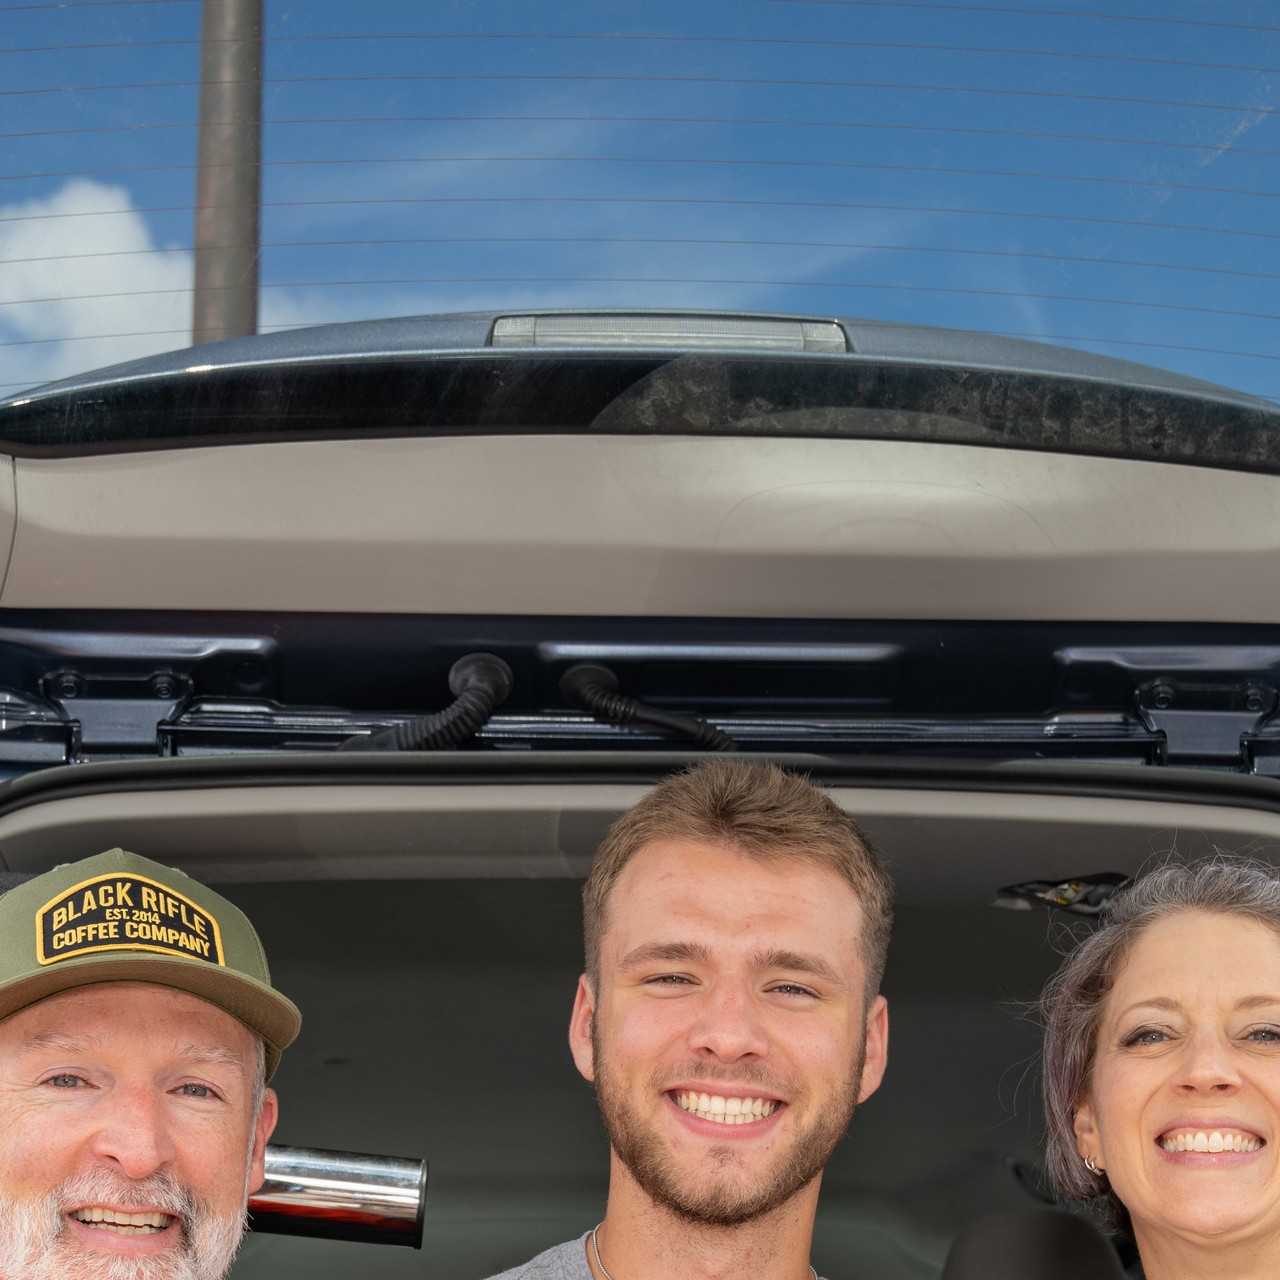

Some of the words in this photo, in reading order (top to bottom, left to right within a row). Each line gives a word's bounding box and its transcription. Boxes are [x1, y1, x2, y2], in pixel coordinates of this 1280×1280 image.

[52, 881, 135, 932] BLACK
[141, 886, 209, 940] RIFLE
[105, 908, 130, 921] EST.
[132, 909, 162, 925] 2014
[52, 922, 119, 950] COFFEE
[125, 922, 211, 957] COMPANY
